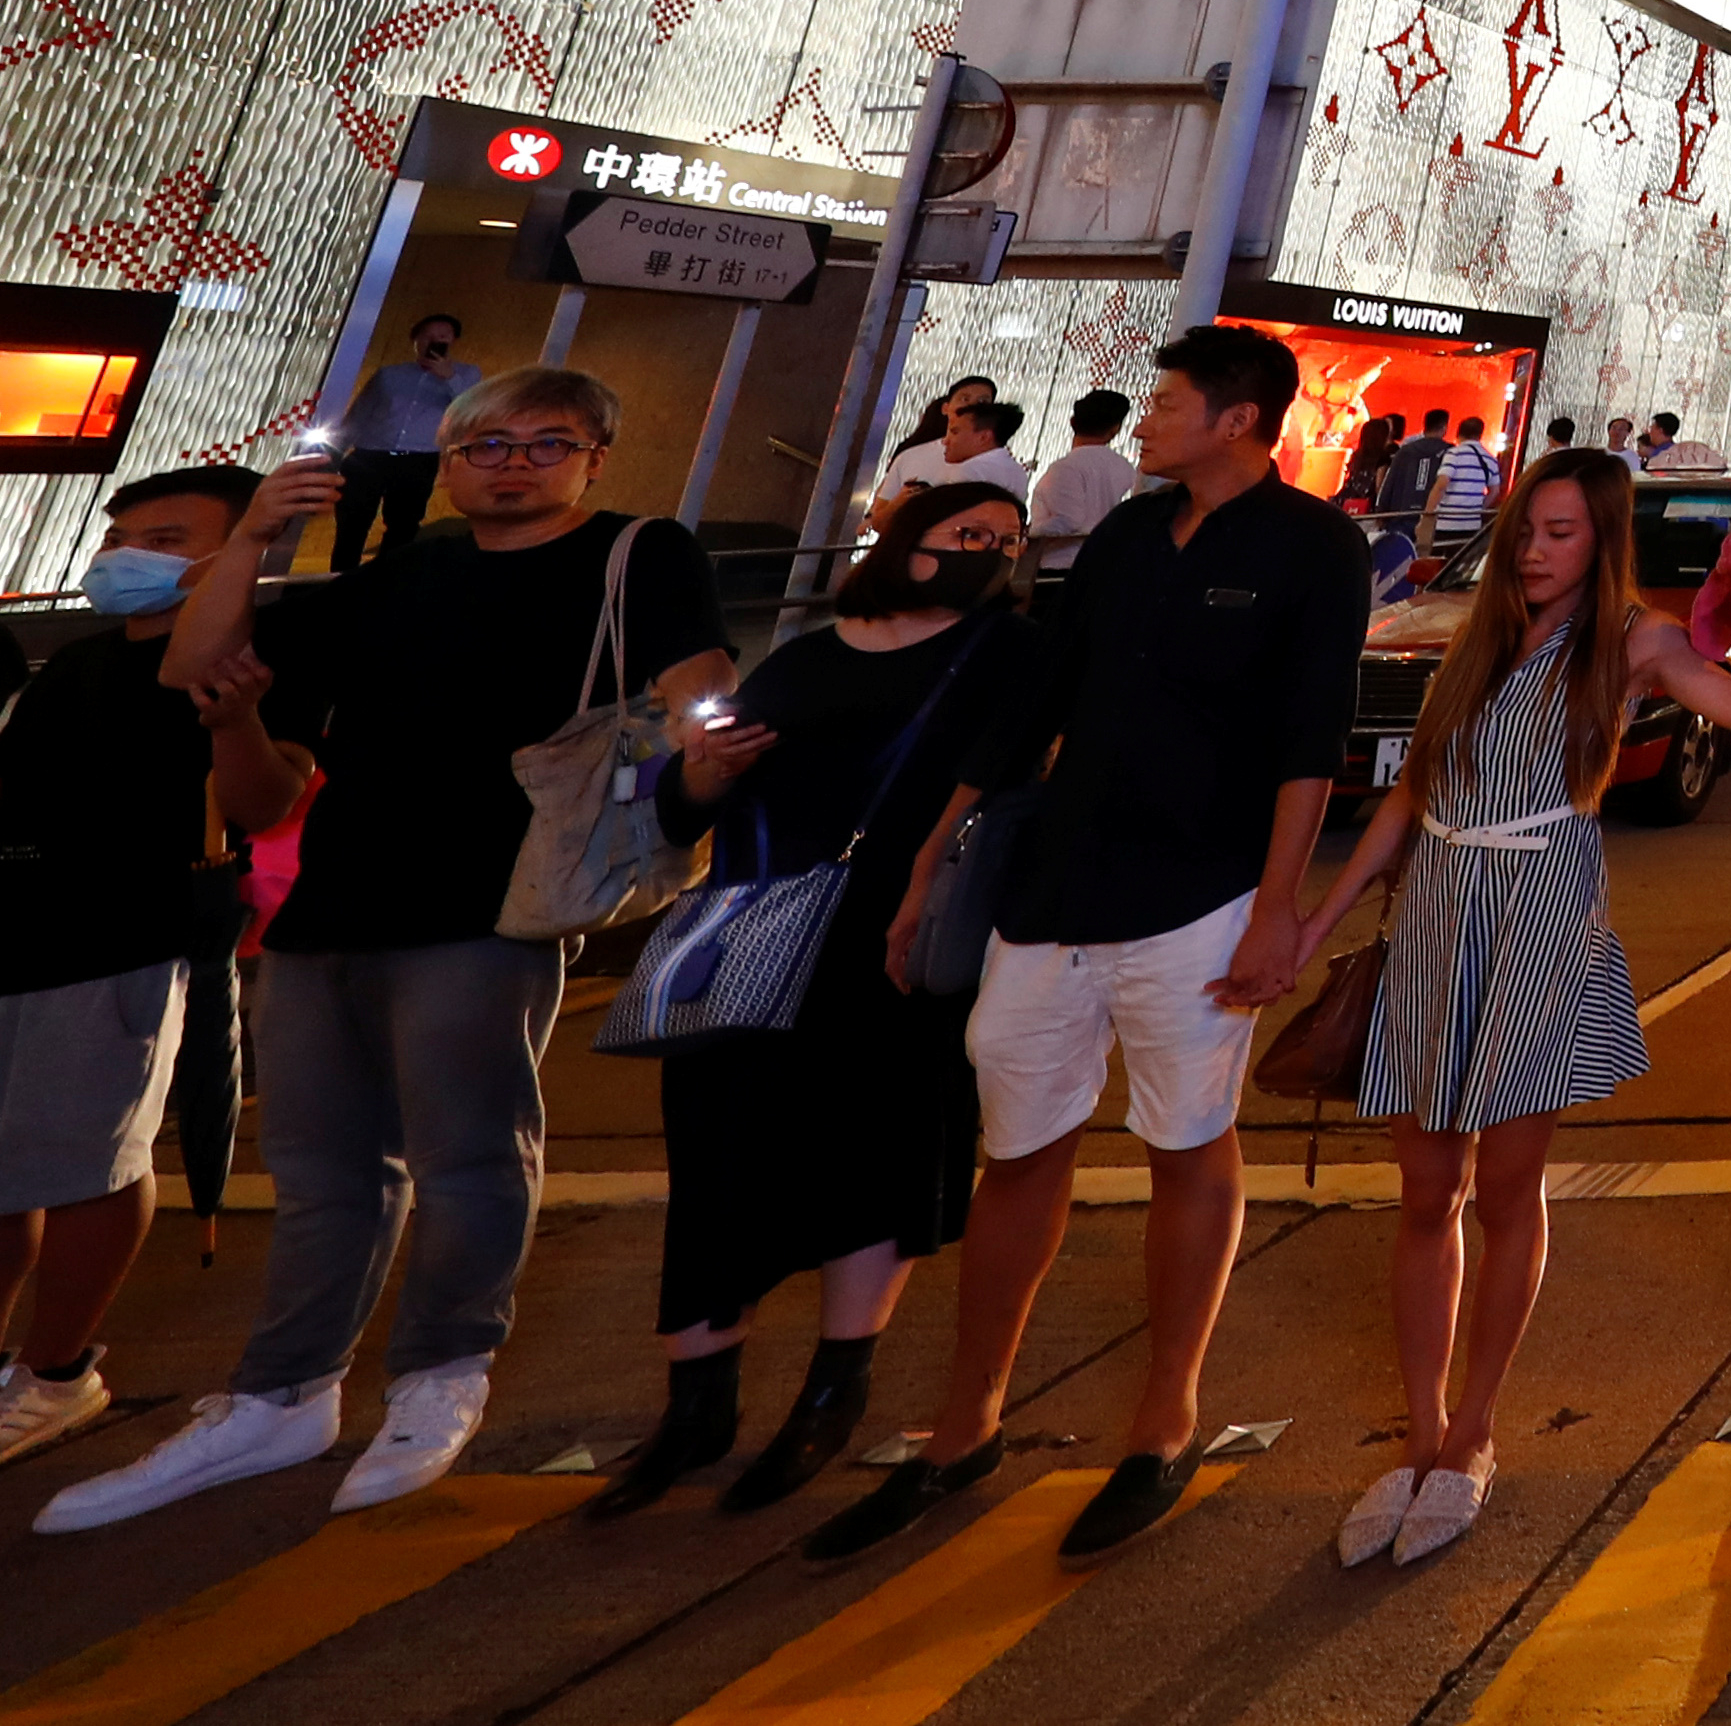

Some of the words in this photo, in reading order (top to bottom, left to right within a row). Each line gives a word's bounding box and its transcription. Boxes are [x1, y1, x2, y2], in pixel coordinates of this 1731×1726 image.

[582, 143, 728, 205] 中環站
[728, 182, 812, 215] Central
[812, 195, 888, 227] Station
[620, 210, 705, 241] Pedder
[715, 223, 786, 251] Street
[754, 268, 788, 285] 17-1
[1332, 297, 1389, 327] LOUIS
[1392, 304, 1464, 335] VUITTON
